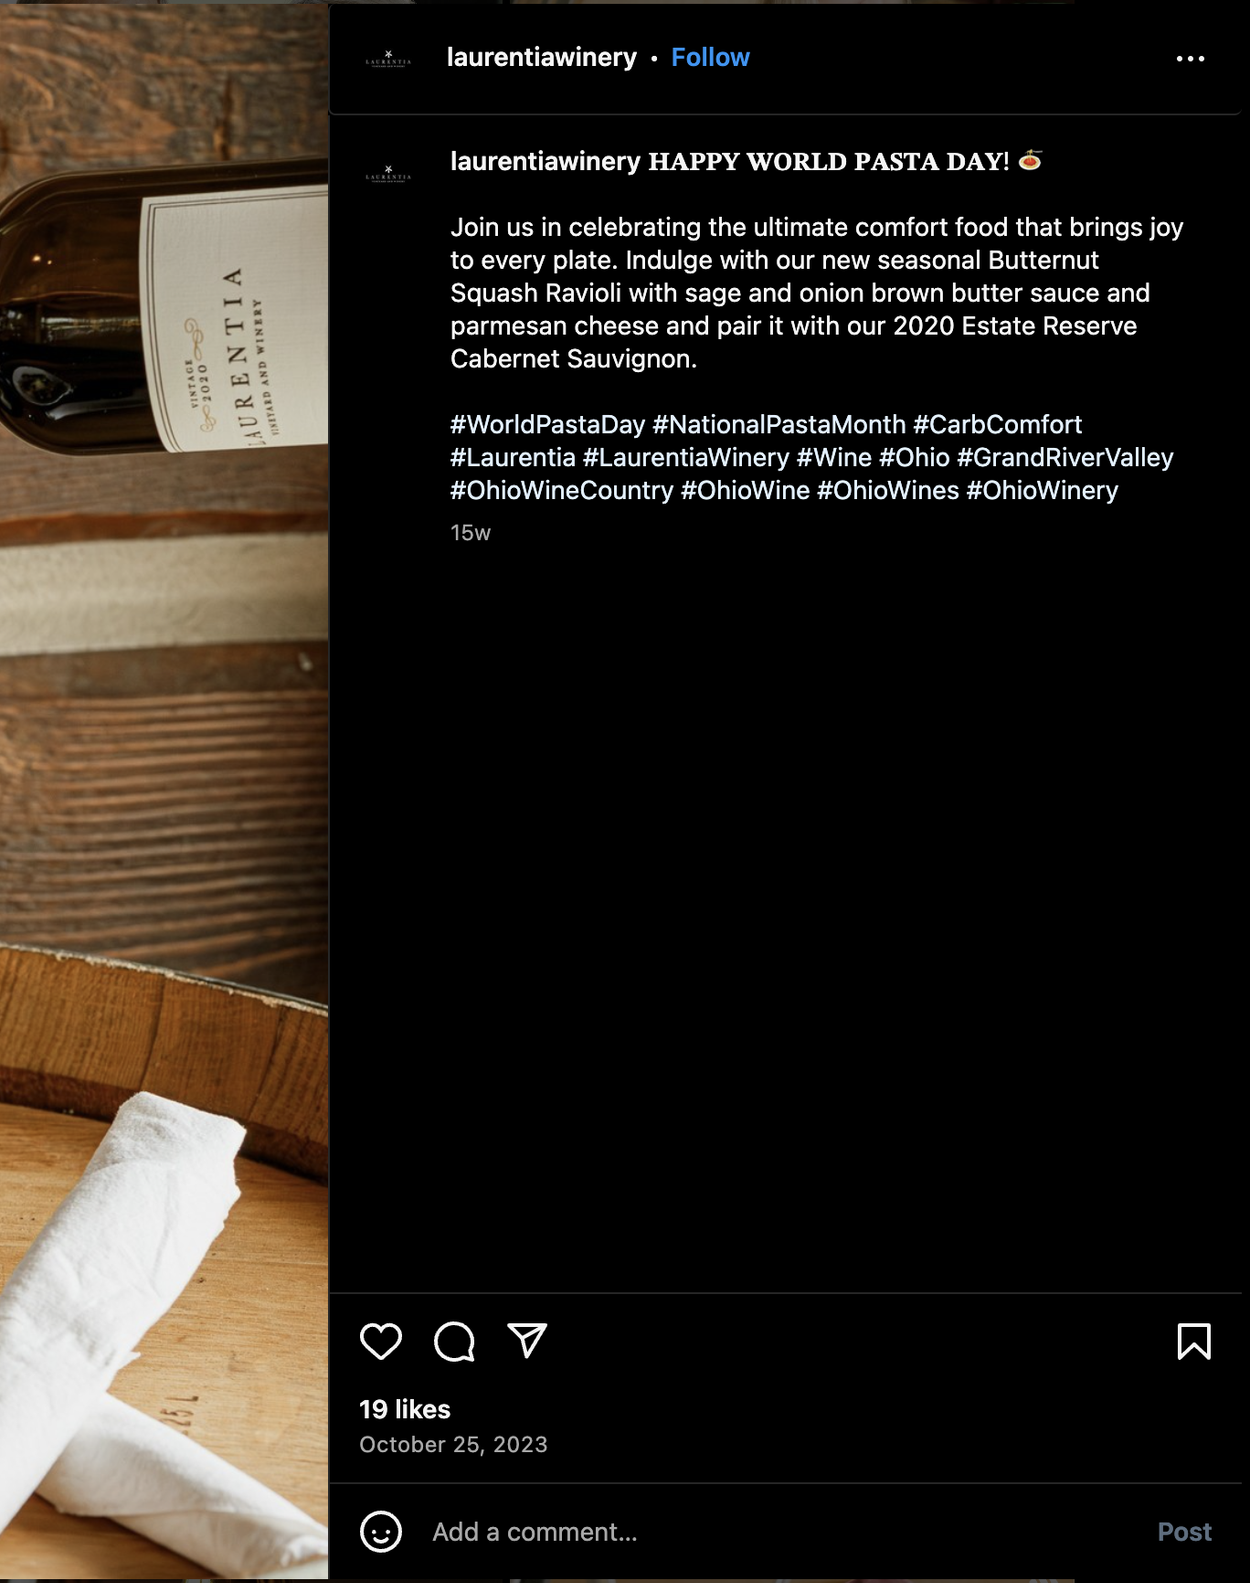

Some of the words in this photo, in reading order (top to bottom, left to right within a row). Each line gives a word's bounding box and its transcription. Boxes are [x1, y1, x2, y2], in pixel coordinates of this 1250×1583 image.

[252, 299, 265, 355] WINERY
[222, 268, 266, 446] LAURENTIA
[258, 361, 269, 386] AND
[185, 359, 199, 409] VINTAGE
[197, 364, 212, 402] 2020
[262, 391, 280, 436] VINEYARD
